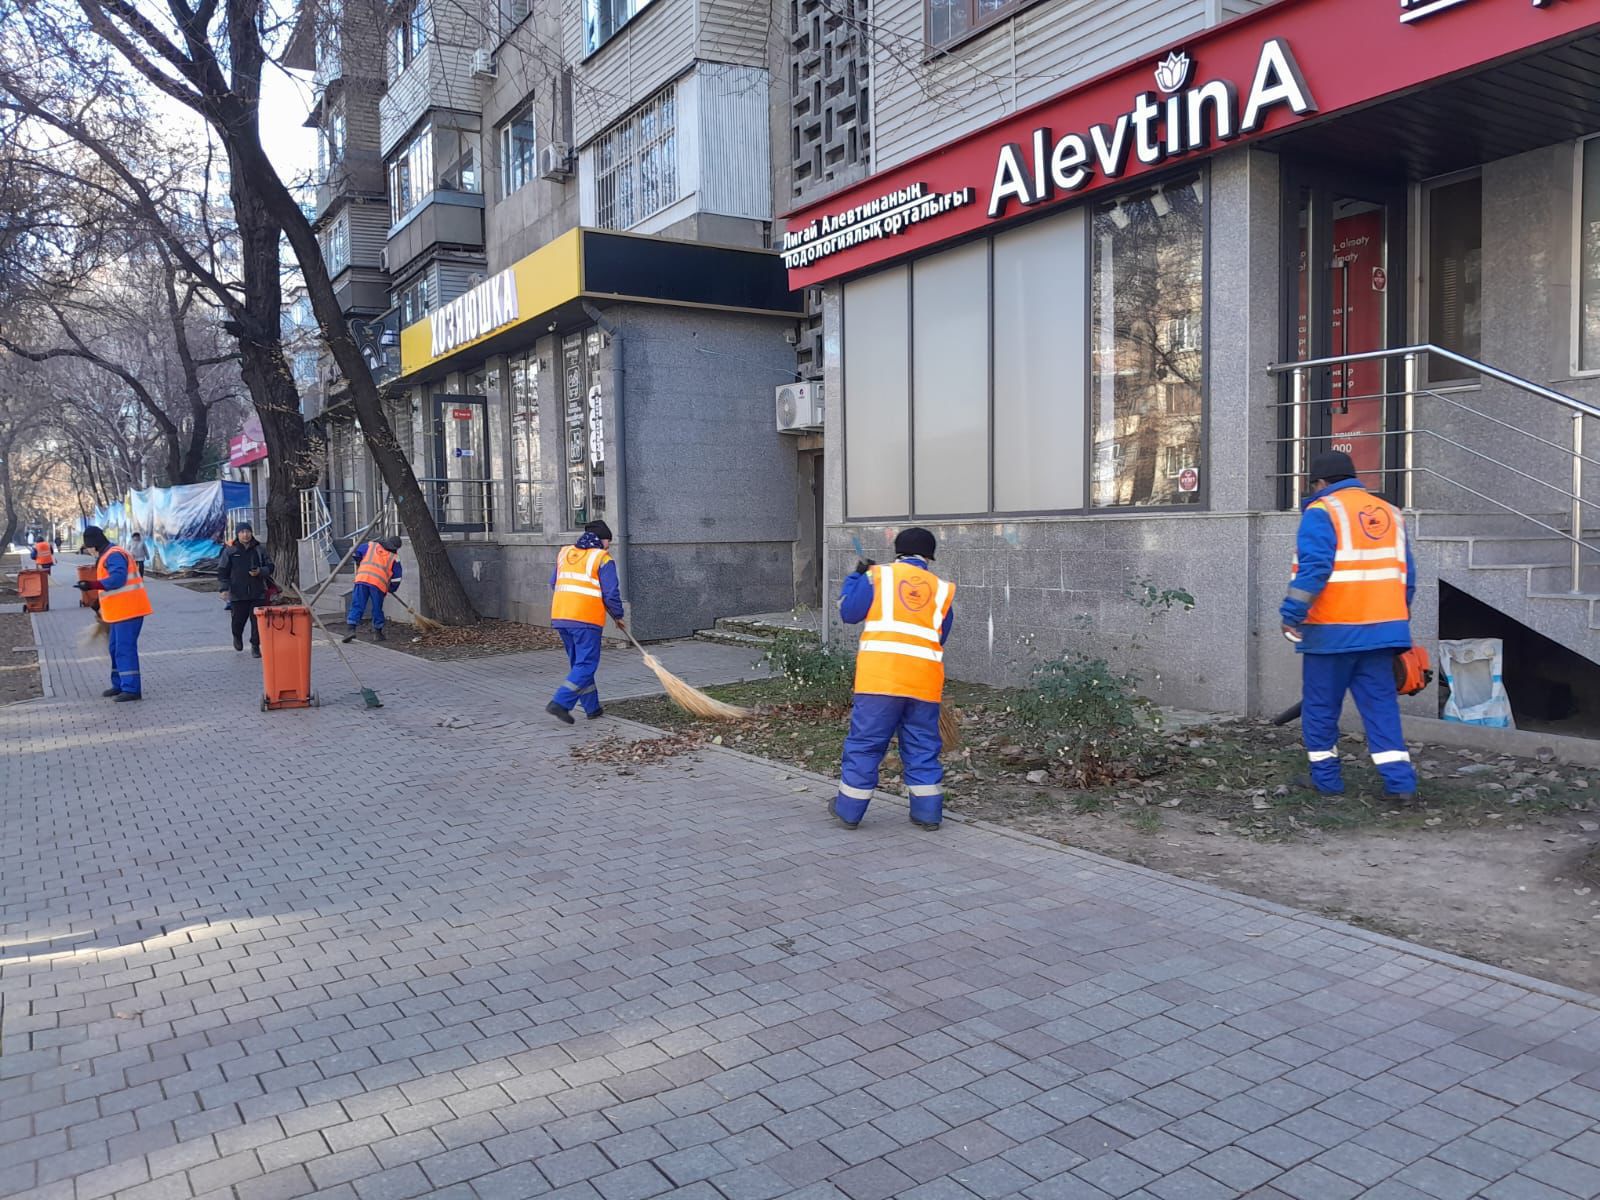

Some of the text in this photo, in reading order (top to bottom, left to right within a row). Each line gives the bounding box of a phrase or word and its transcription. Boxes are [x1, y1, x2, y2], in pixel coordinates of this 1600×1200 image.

[986, 39, 1308, 218] AlevtinA
[783, 219, 818, 250] Лигай
[785, 187, 969, 269] подологиялық орталығы
[431, 268, 517, 358] ХОЗЯЮШКА
